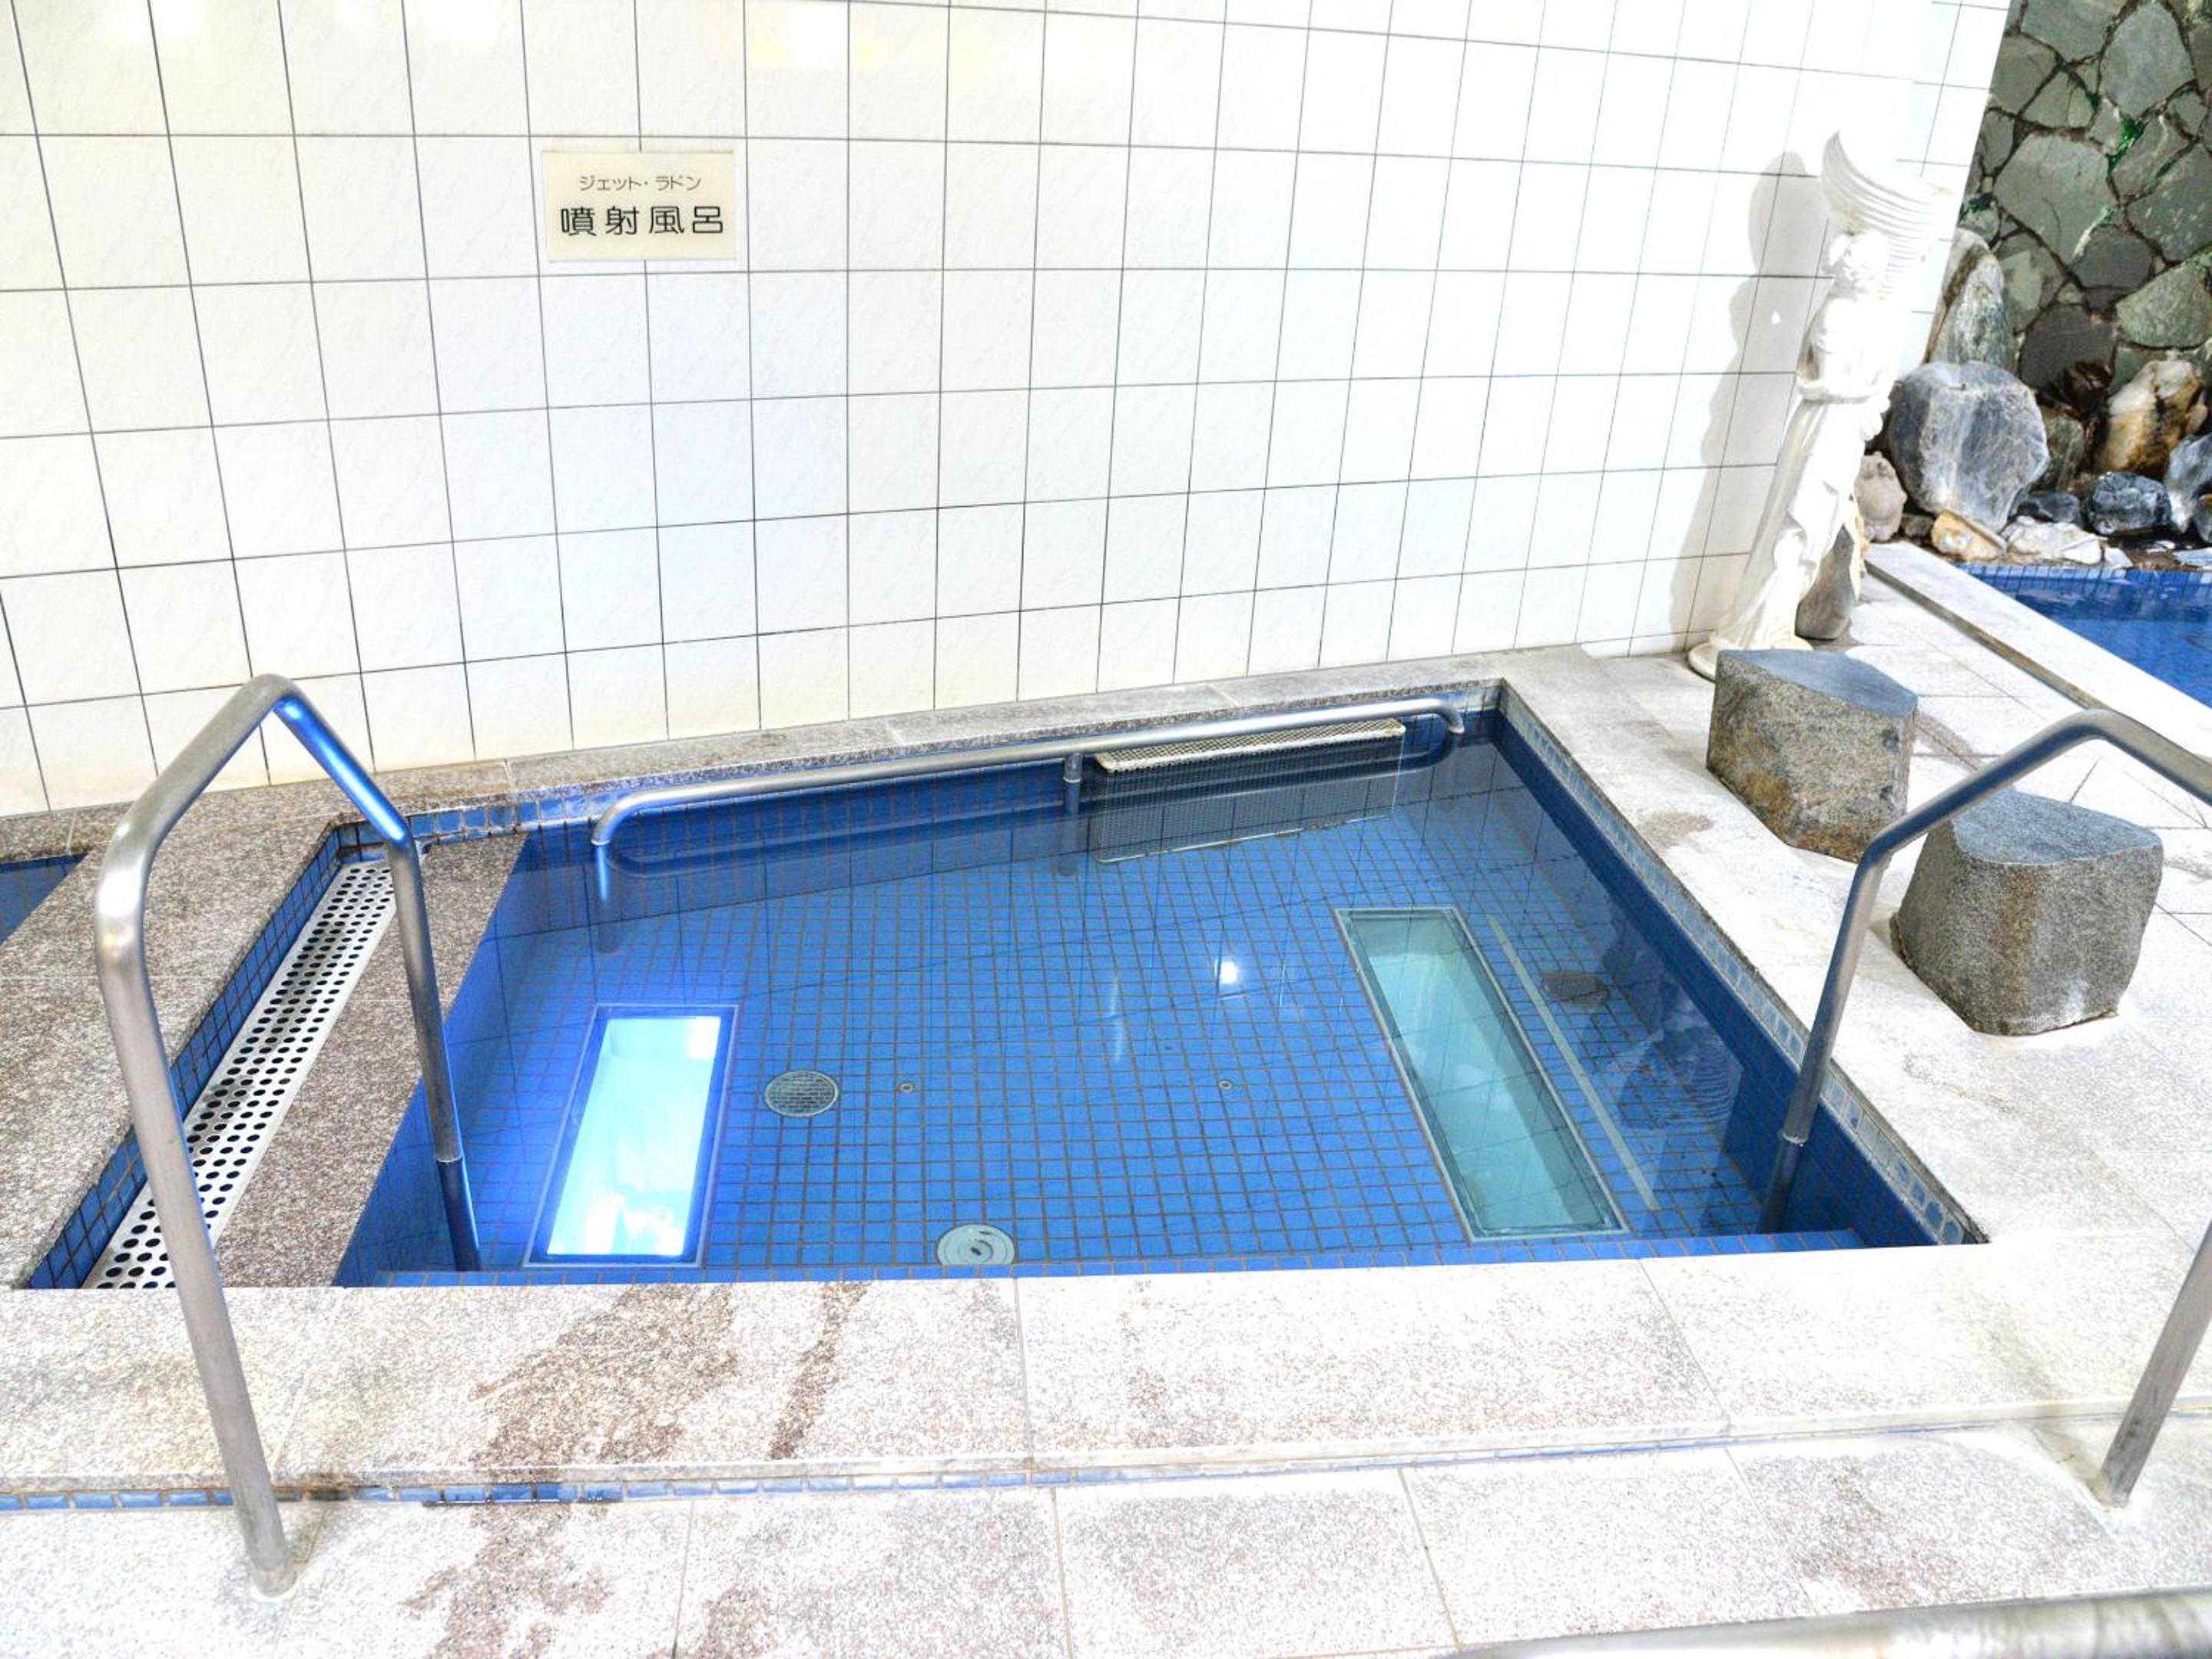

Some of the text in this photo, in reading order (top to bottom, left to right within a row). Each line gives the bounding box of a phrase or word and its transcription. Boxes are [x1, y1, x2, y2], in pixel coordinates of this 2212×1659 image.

[579, 175, 701, 190] ジェット・ラドン
[561, 205, 724, 236] 噴射風呂
